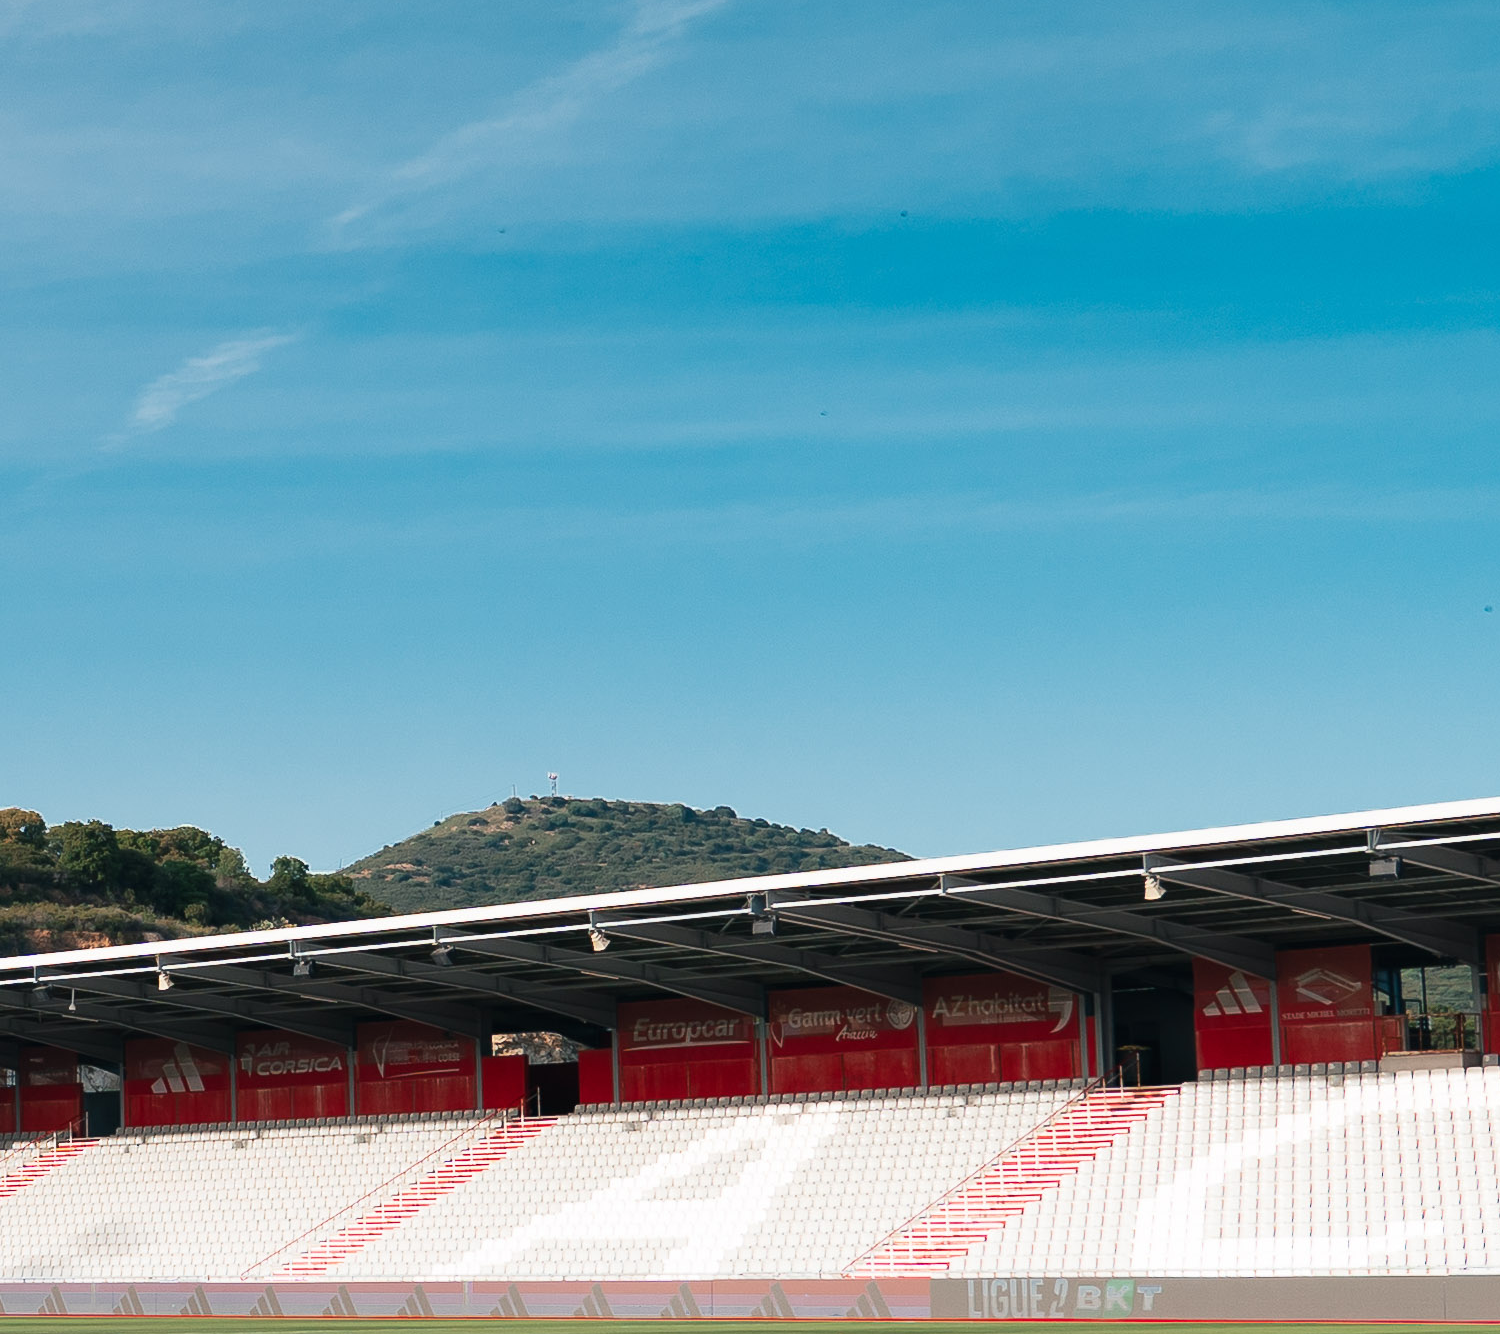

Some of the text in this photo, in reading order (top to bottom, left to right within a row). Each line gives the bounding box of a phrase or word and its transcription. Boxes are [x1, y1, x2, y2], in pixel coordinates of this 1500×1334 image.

[932, 992, 1046, 1018] AZ habitat
[633, 1018, 740, 1044] Europcar
[256, 1042, 291, 1058] AIR
[257, 1056, 343, 1076] CORSICA
[967, 1278, 1162, 1318] LIGUE 2 BKT
